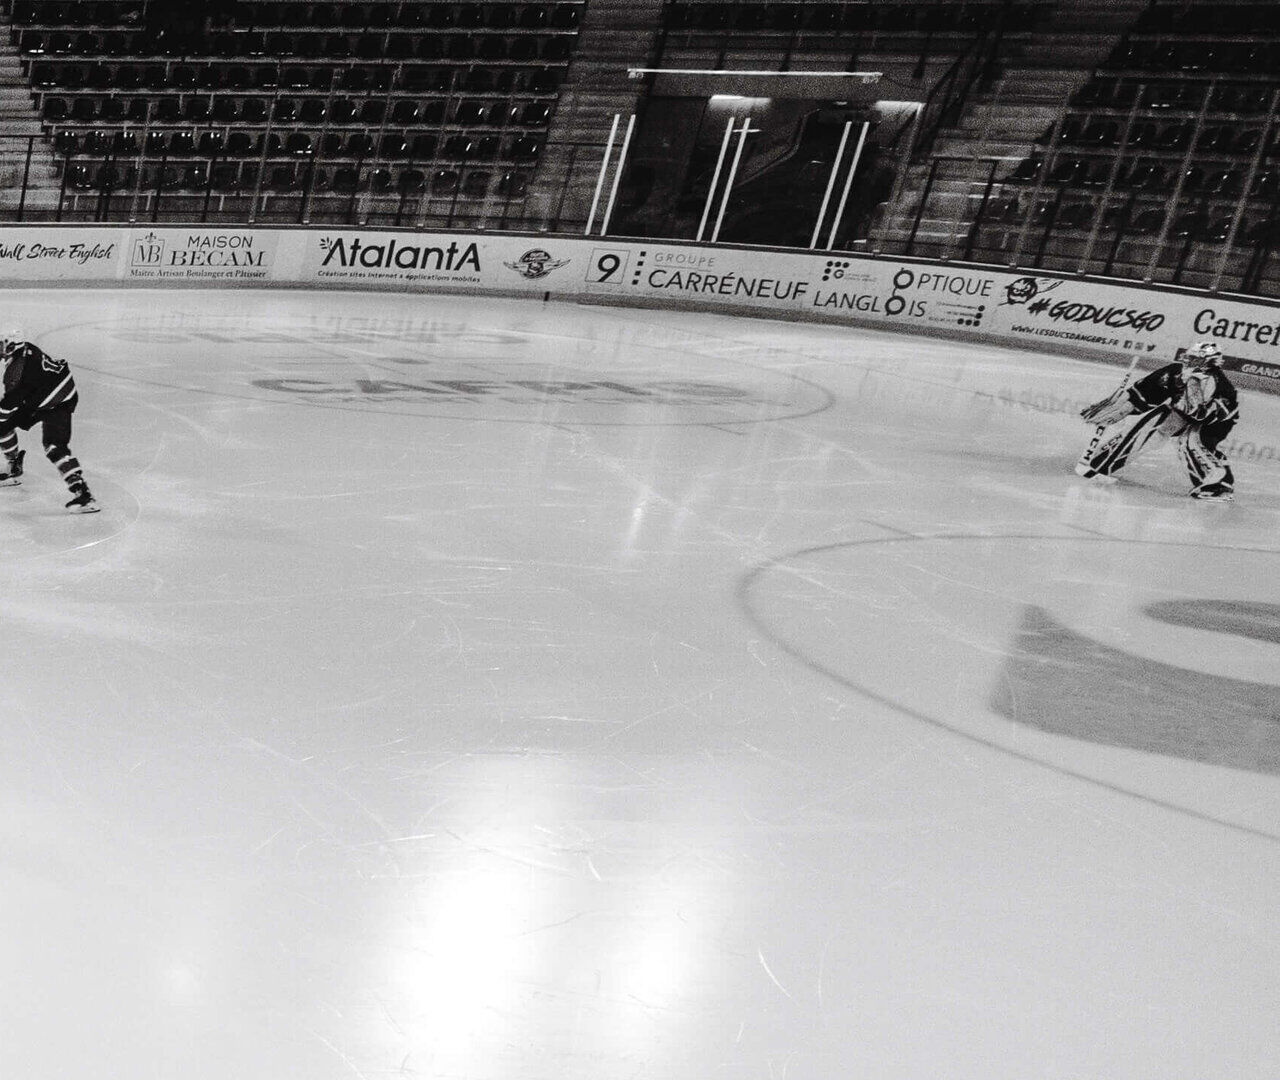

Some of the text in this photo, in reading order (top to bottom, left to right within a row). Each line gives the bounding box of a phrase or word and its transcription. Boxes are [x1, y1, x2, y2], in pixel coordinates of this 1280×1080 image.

[26, 243, 66, 259] Street
[68, 243, 115, 264] English
[187, 235, 253, 249] MAISON
[170, 250, 268, 267] BECAM
[598, 253, 621, 283] 9
[654, 252, 717, 268] GROUPE
[647, 270, 810, 300] CARRÉNEUF
[893, 267, 995, 297] OPTIQUE
[814, 290, 928, 317] LANGLOIS
[1027, 298, 1166, 334] #GODUCSGO
